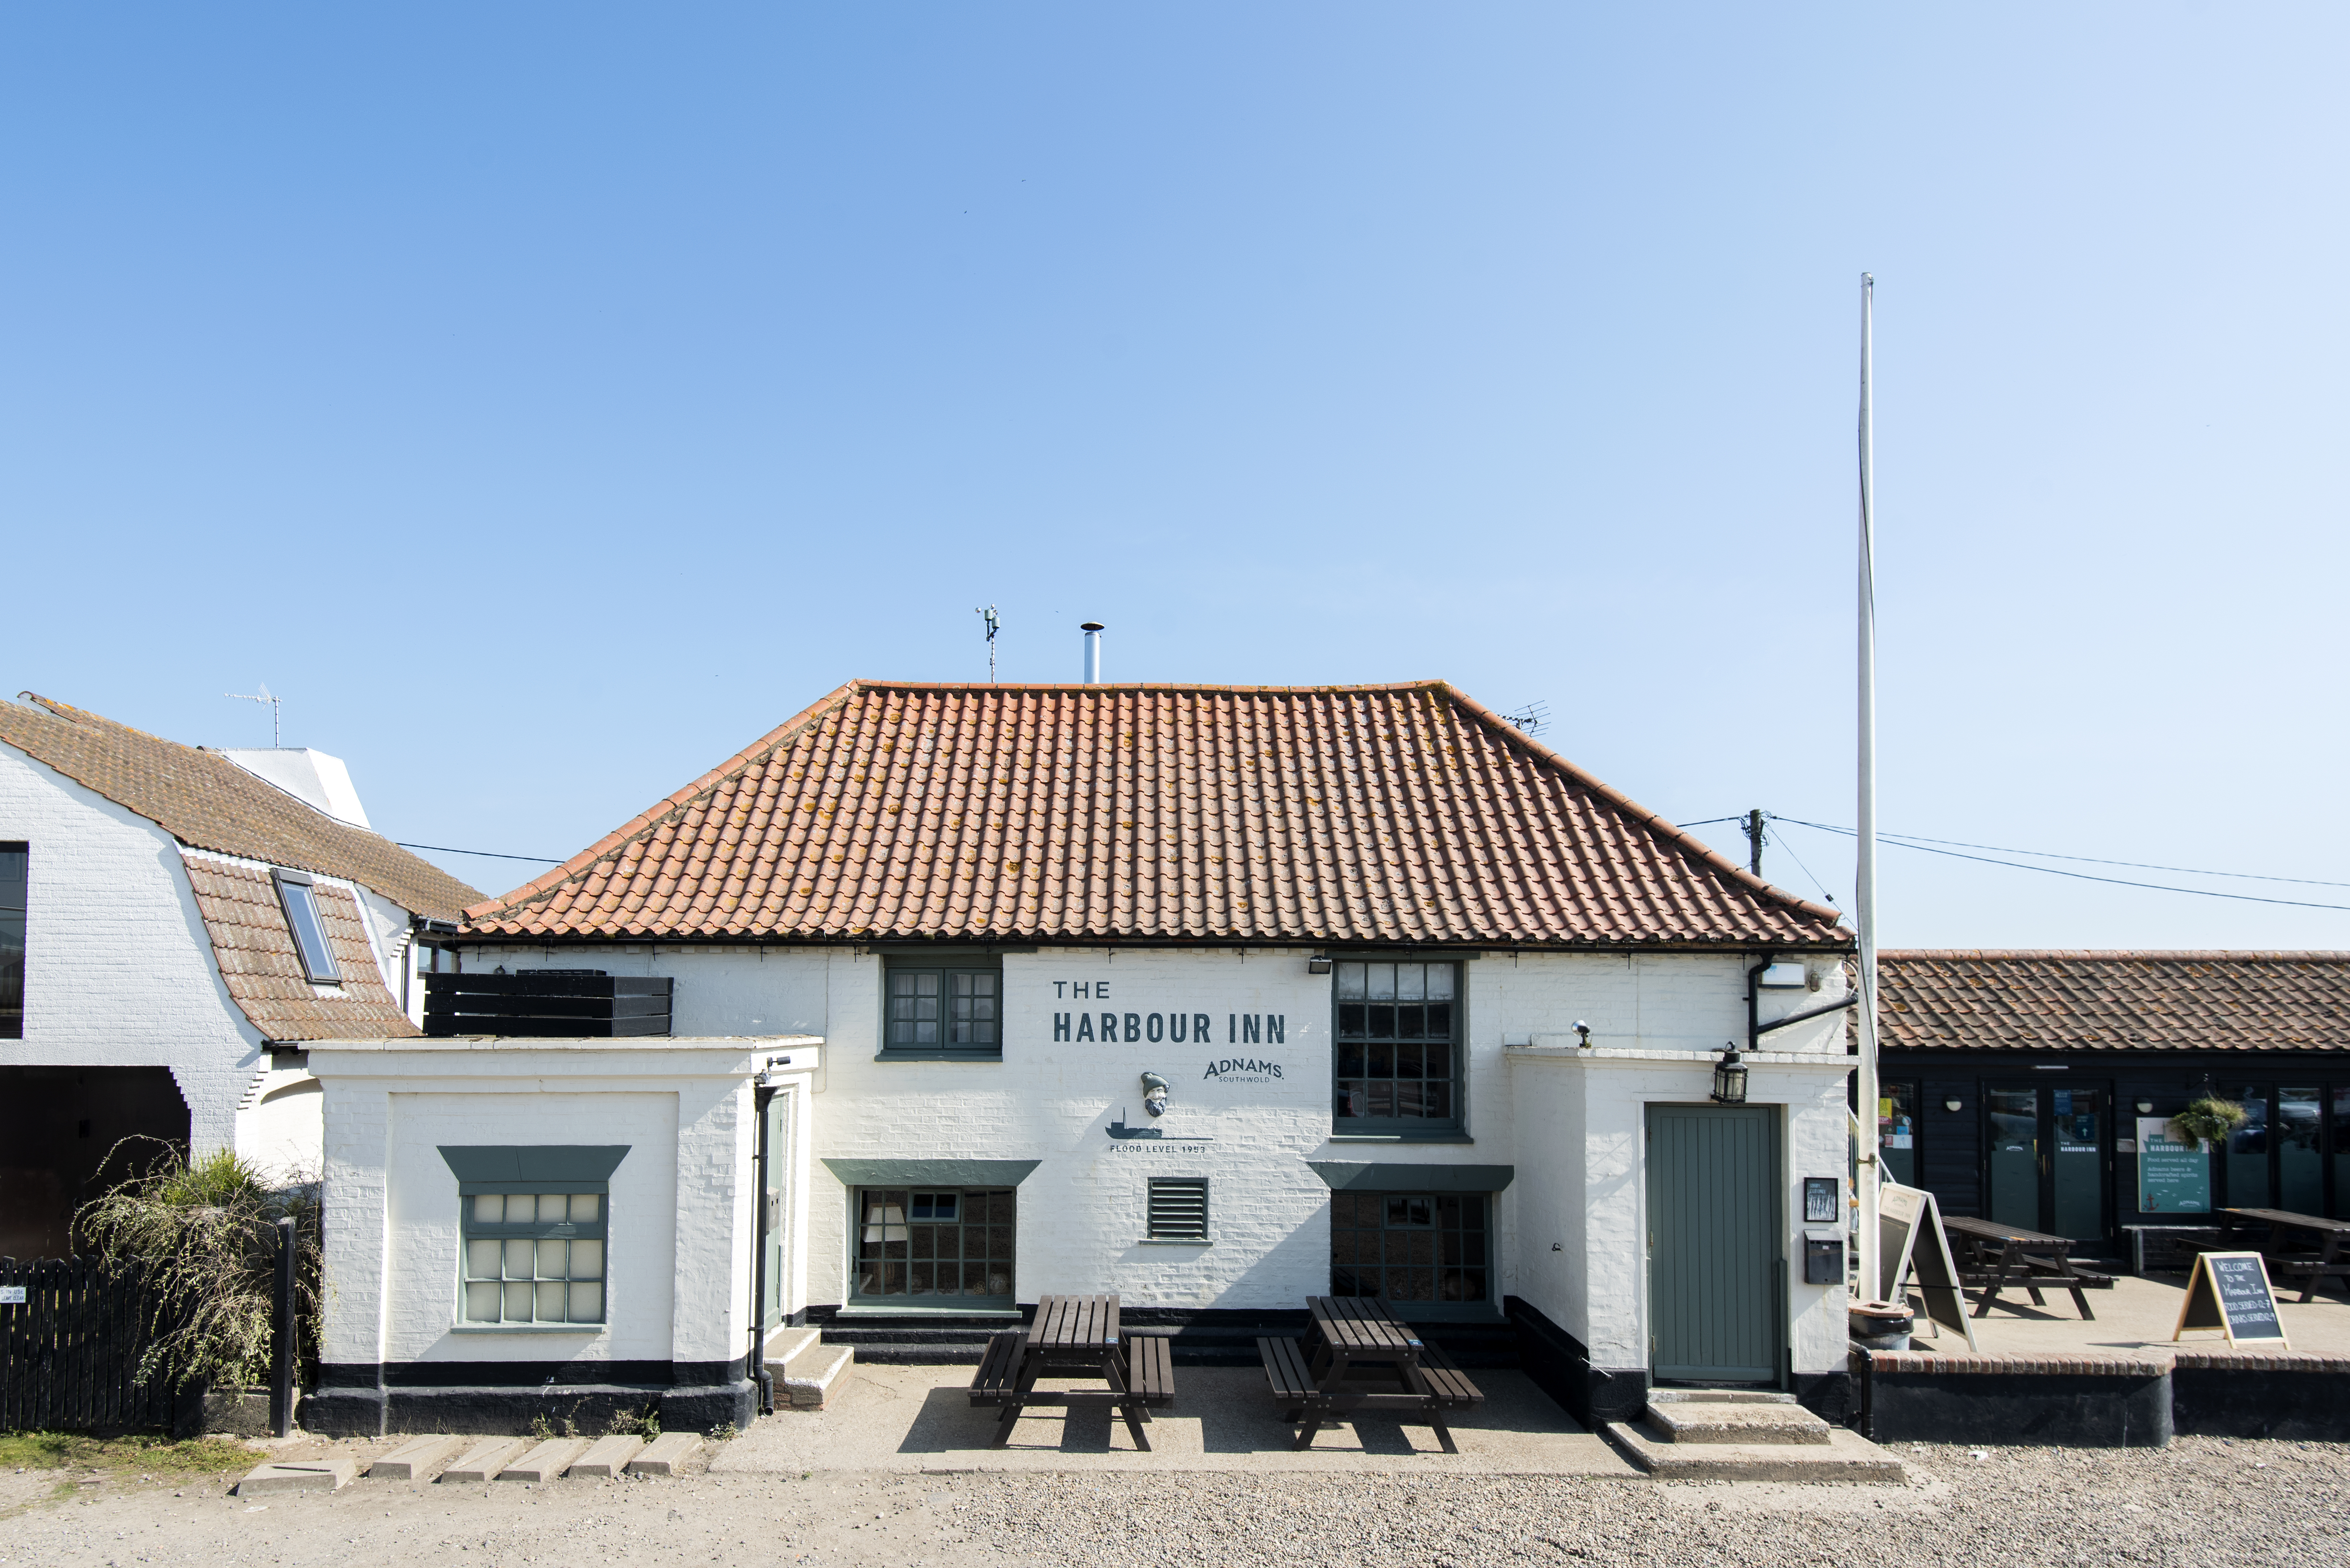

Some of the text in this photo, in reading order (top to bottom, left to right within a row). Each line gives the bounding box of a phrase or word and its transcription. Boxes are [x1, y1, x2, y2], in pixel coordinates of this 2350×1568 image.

[1053, 982, 1110, 999] THE
[1054, 1013, 1284, 1043] HARBOUR INN
[1892, 1196, 1908, 1207] ADNAMS
[2216, 1261, 2254, 1272] WELCOME
[2224, 1302, 2239, 1311] FOOD
